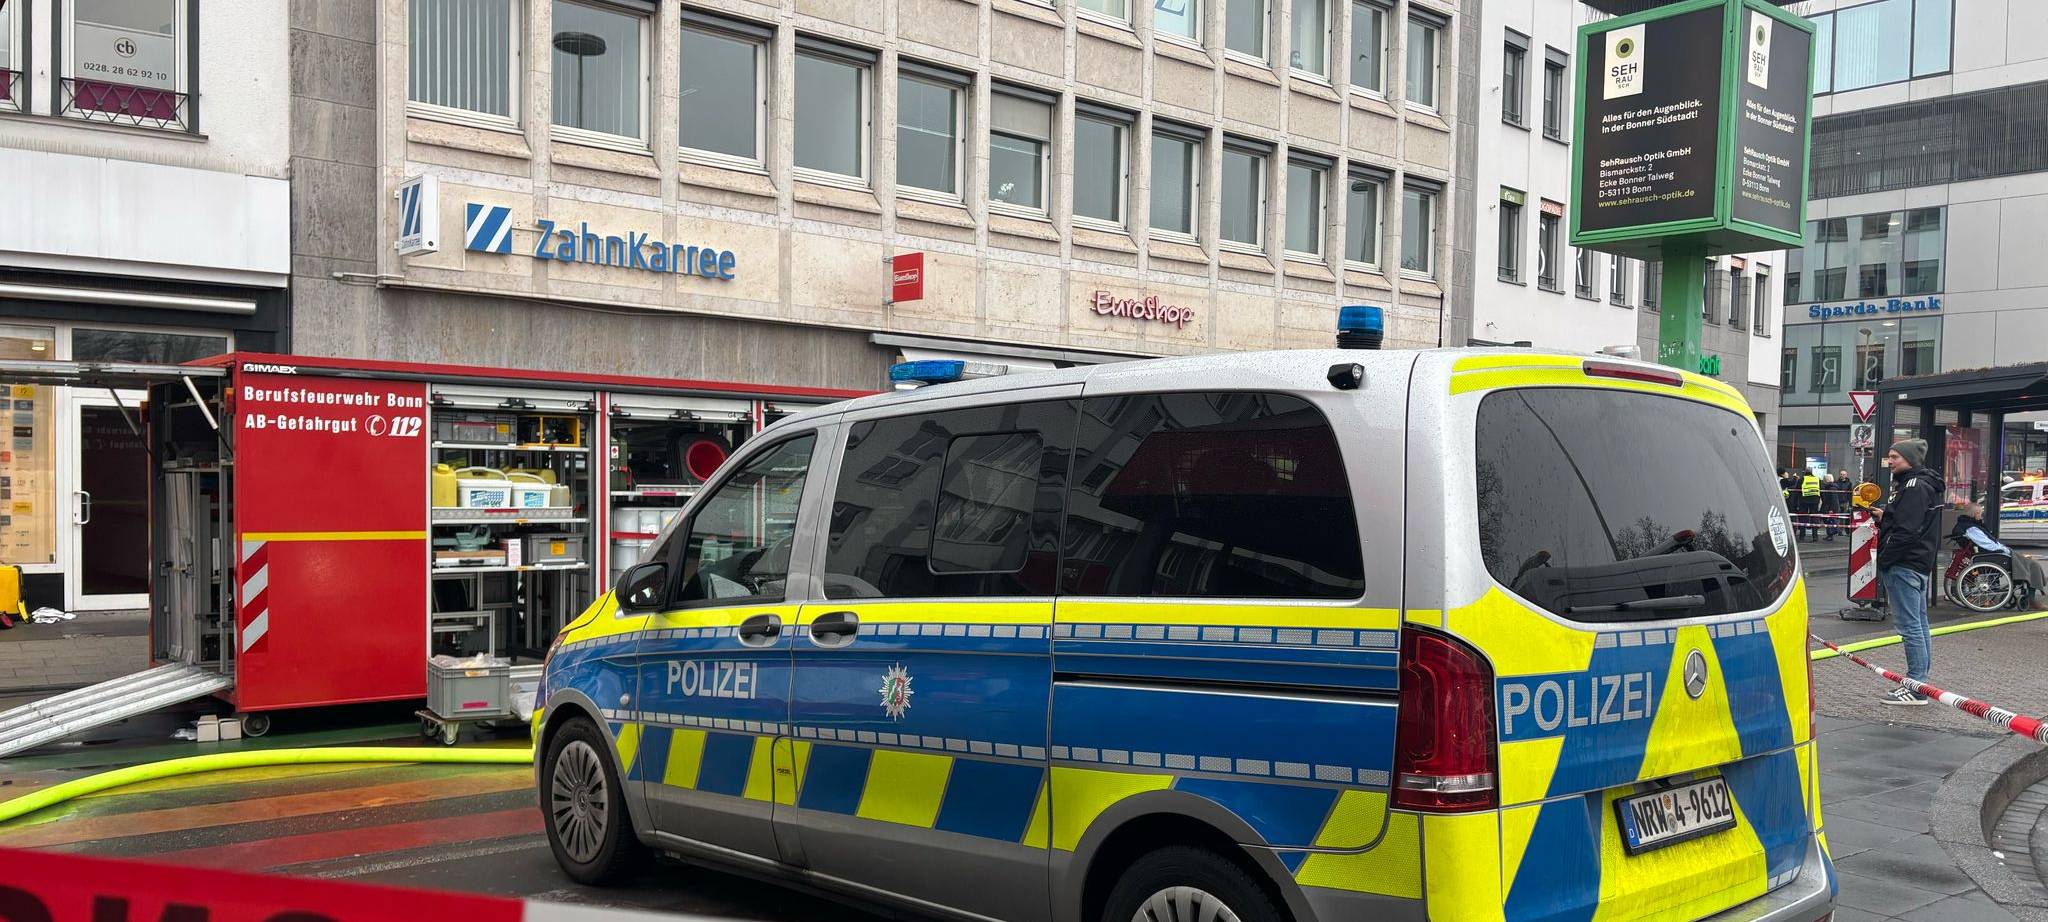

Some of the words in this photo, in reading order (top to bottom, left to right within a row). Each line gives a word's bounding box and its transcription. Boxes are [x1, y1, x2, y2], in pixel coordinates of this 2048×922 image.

[116, 40, 135, 54] cb
[1752, 50, 1766, 66] SEH
[84, 62, 109, 73] 0228.
[112, 66, 124, 75] 28
[127, 68, 138, 77] 62
[142, 70, 152, 79] 92
[156, 72, 167, 81] 10
[1611, 62, 1638, 77] SEH
[1616, 75, 1632, 84] RAU
[1602, 114, 1622, 123] Alles
[1624, 111, 1635, 119] für
[1637, 109, 1652, 118] den
[1654, 99, 1702, 115] Augenblick.
[1602, 126, 1609, 134] In
[1611, 124, 1624, 132] der
[1626, 119, 1655, 130] Bonner
[1656, 110, 1698, 125] Südstadt!
[1600, 155, 1642, 168] SehRausch
[1644, 152, 1665, 162] Optik
[1666, 147, 1691, 158] GmbH
[1600, 166, 1646, 178] Bismarckstr.
[1600, 179, 1617, 188] Ecke
[1619, 176, 1646, 185] Bonner
[1648, 172, 1674, 181] Talweg
[1599, 187, 1630, 198] D-53113
[1632, 185, 1652, 194] Bonn
[1599, 189, 1694, 208] www.sehrausch-optik.de
[535, 218, 736, 280] ZahnKarree
[1095, 290, 1192, 330] EuroShop
[1808, 296, 1941, 320] Sparda-Bank
[243, 364, 297, 374] GIMAEX
[244, 386, 380, 406] Berufsfeuerwehr
[387, 393, 423, 408] Bonn
[245, 414, 357, 434] AB-Gefahrgut
[388, 416, 422, 437] 112
[667, 660, 758, 700] POLIZEI
[1503, 672, 1652, 735] POLIZEI
[1631, 797, 1668, 839] NRW
[1673, 784, 1730, 826] 4-9612
[1629, 828, 1634, 838] D
